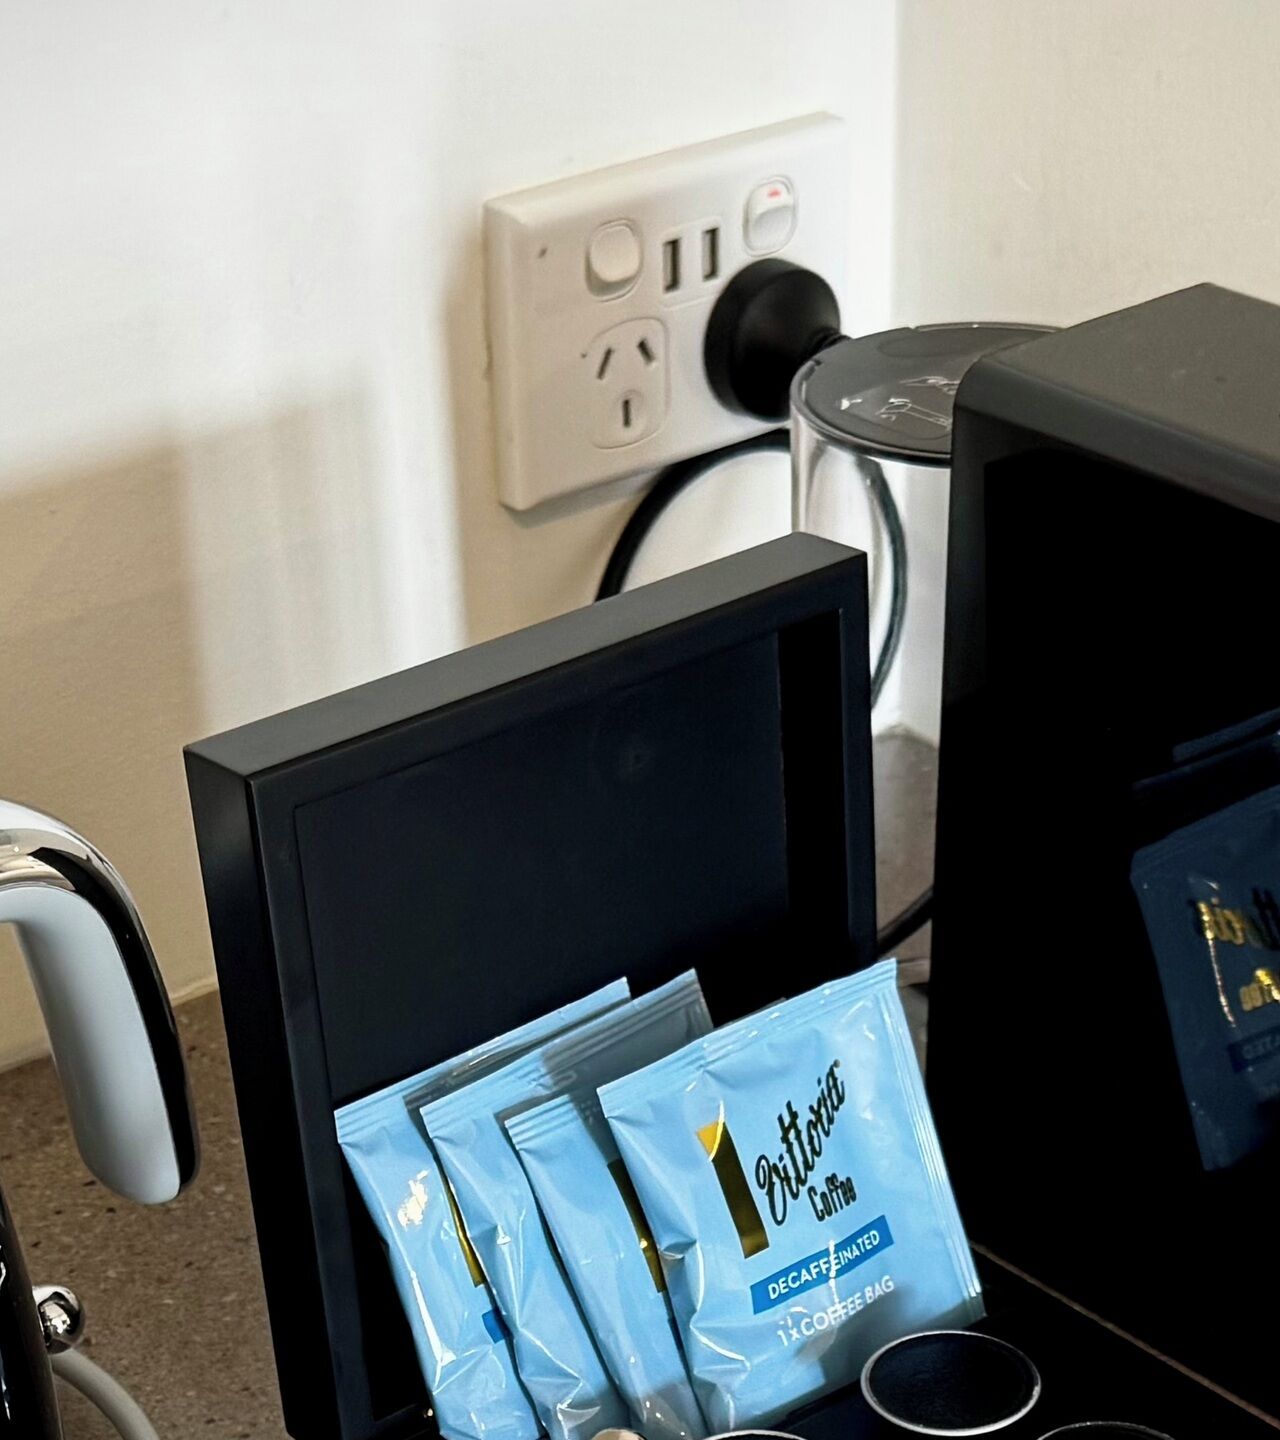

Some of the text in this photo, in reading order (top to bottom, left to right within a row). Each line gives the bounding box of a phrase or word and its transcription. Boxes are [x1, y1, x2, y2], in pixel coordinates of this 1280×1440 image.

[754, 1064, 847, 1226] Vittoria
[807, 1171, 858, 1222] Coffee
[767, 1229, 880, 1300] DECAFFEINATED
[865, 1275, 895, 1305] BAG
